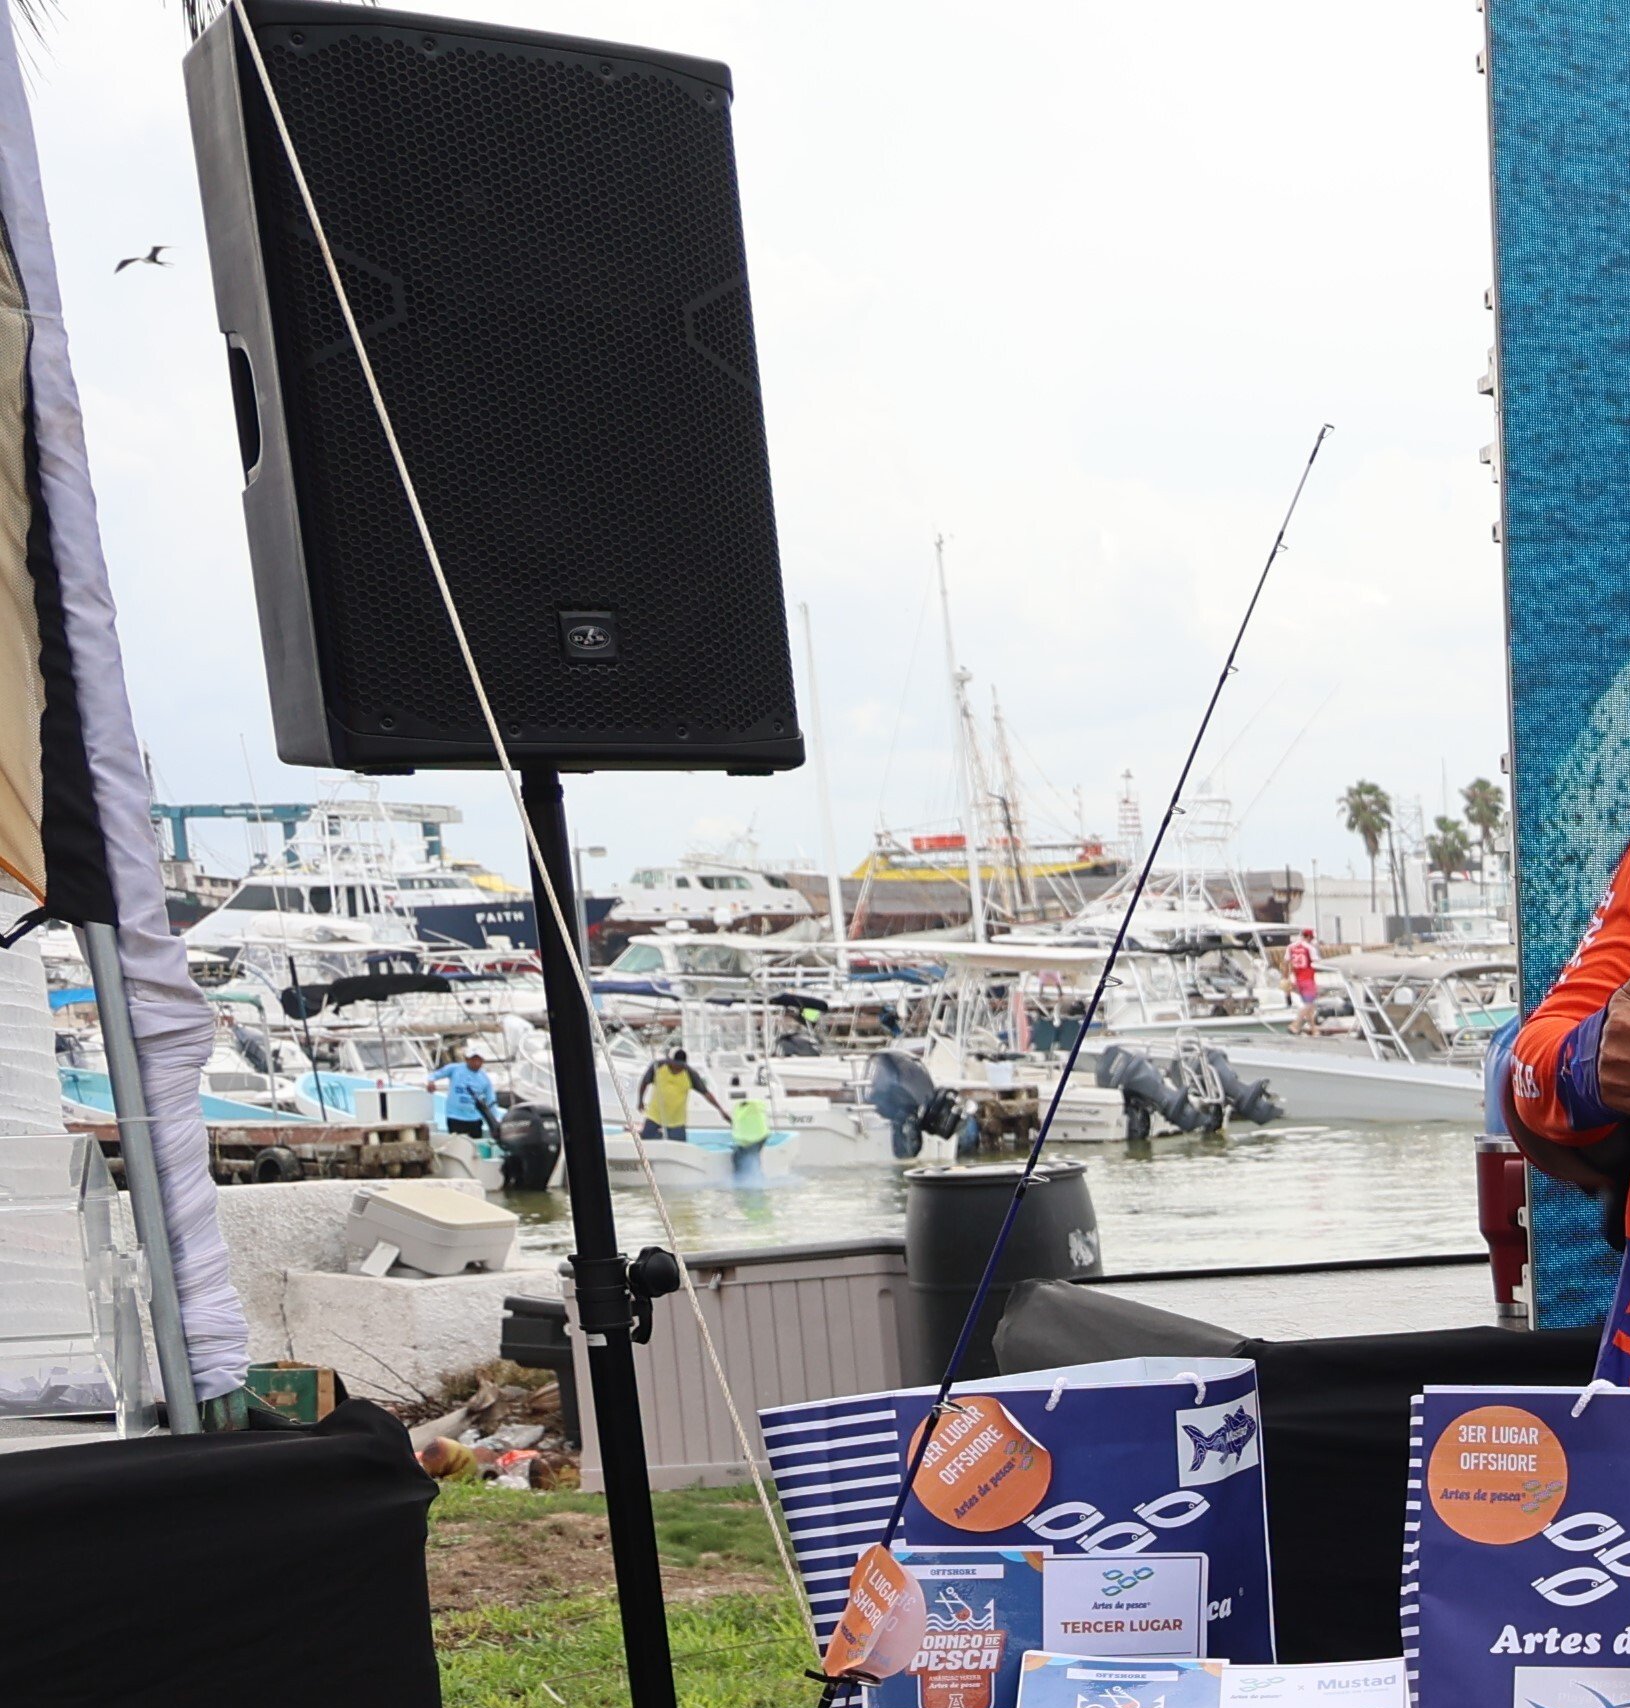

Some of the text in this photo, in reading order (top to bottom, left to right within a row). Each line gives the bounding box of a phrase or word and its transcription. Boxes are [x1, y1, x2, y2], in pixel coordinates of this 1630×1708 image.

[475, 910, 525, 924] FAITH
[1458, 1426, 1539, 1445] 3ER LUGAR
[938, 1422, 1004, 1488] OFFSHORE
[1460, 1452, 1537, 1472] OFFSHORE
[1060, 1618, 1183, 1634] TERCER LUGAR
[1490, 1624, 1602, 1654] Artes
[910, 1649, 999, 1671] PESCA
[1317, 1674, 1396, 1690] Mustad
